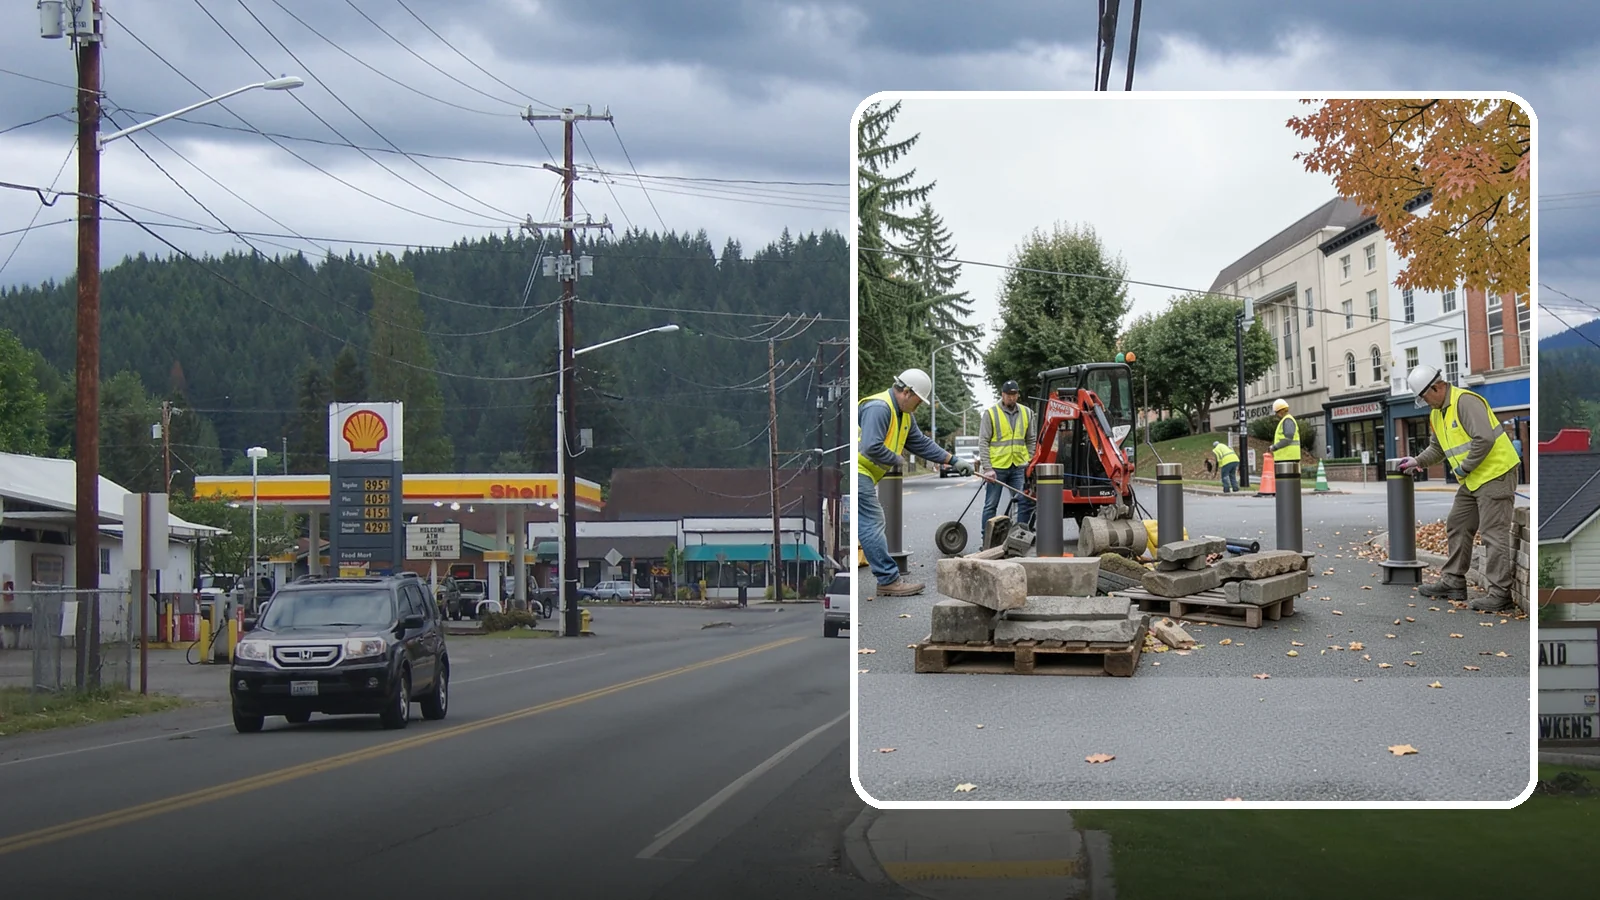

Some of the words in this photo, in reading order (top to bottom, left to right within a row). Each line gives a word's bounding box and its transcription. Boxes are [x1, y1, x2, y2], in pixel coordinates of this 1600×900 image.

[366, 480, 383, 490] 395
[490, 484, 547, 499] Shell
[366, 494, 383, 504] 405
[366, 508, 383, 518] 415
[366, 523, 383, 533] 429
